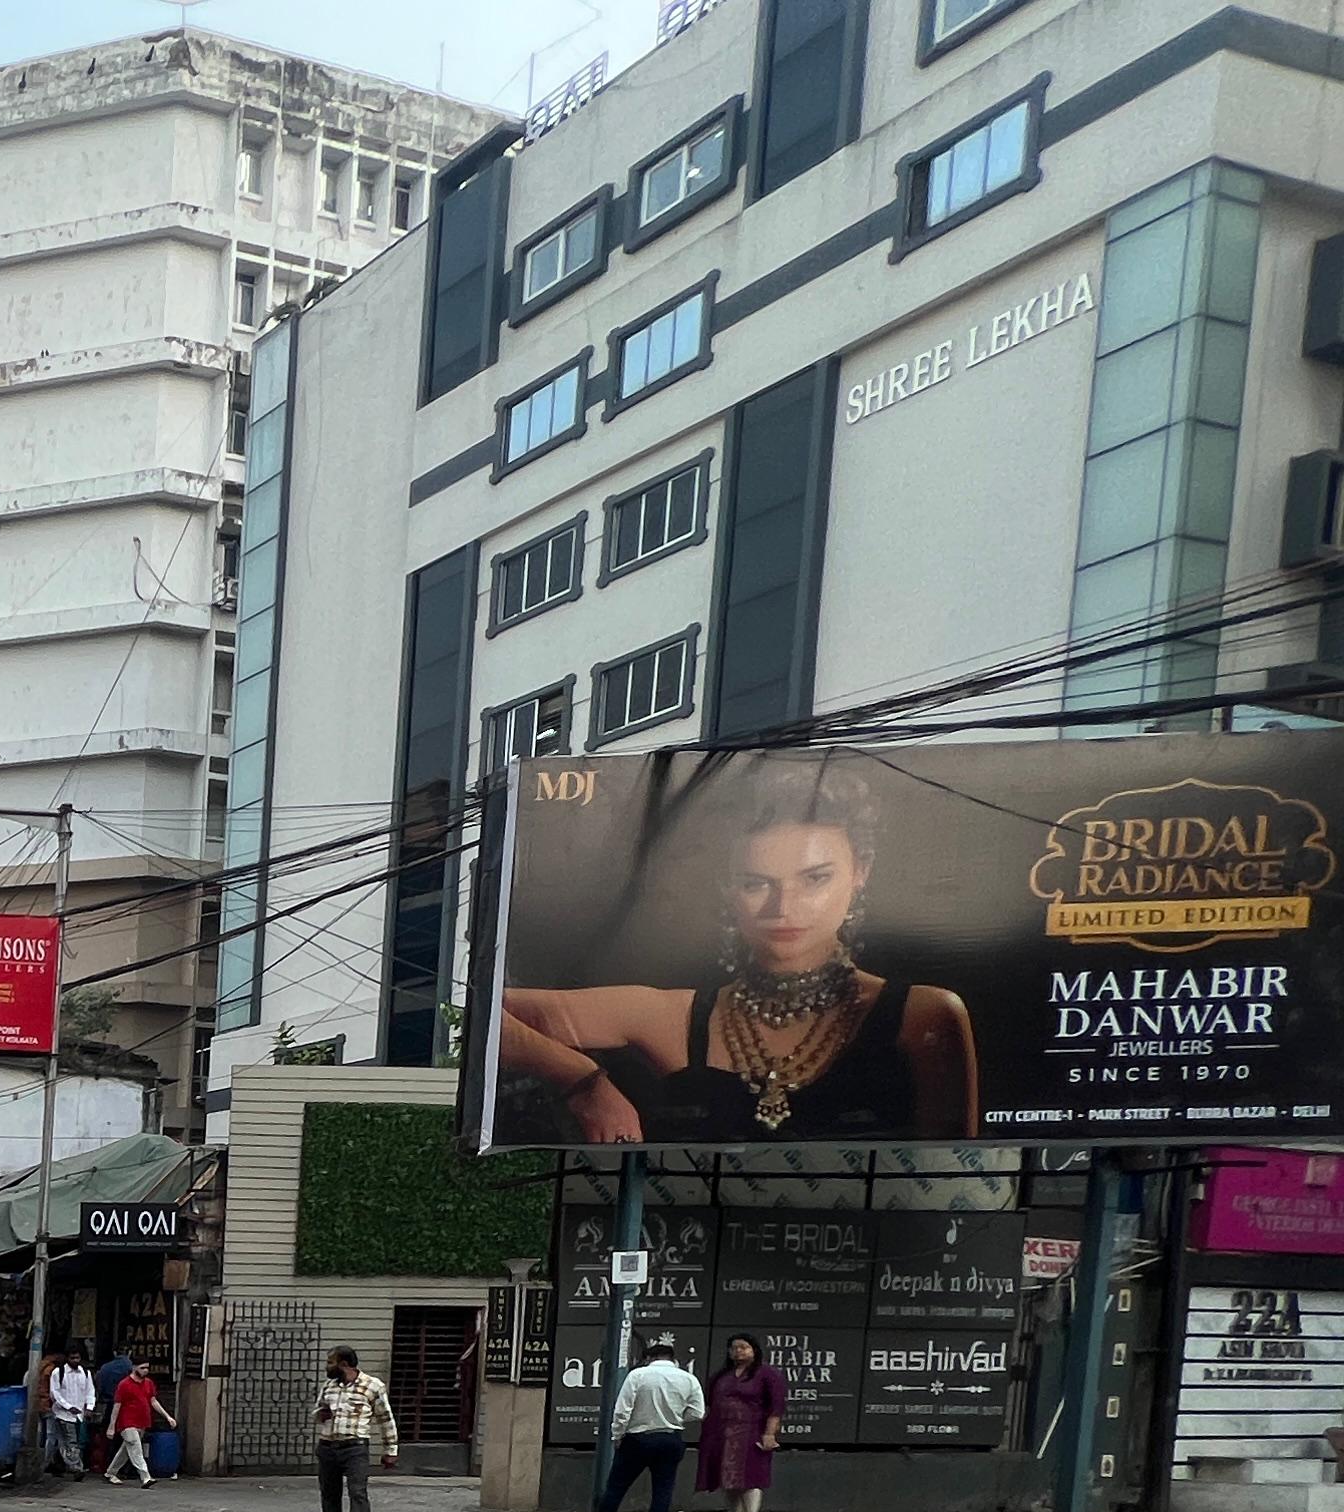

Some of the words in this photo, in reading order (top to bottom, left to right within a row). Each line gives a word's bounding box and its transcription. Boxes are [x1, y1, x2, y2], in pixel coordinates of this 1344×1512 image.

[845, 339, 953, 426] SHREE
[964, 272, 1095, 370] LEKHA
[534, 768, 600, 807] MDJ
[1080, 815, 1287, 863] BRIDAL
[1078, 860, 1285, 897] RADIANCE
[1058, 910, 1166, 928] LIMITED
[1184, 905, 1297, 925] EDITION
[1048, 966, 1289, 1003] MAHABIR
[1054, 1002, 1274, 1039] DANWAR
[1108, 1040, 1214, 1058] JEWELLERS
[1068, 1067, 1161, 1083] SINCE
[1181, 1065, 1251, 1081] 1970
[985, 1110, 1012, 1123] CITY
[1124, 1107, 1170, 1120] STREET
[727, 1223, 777, 1251] THE
[783, 1223, 869, 1252] BRIDAL
[1024, 1240, 1076, 1260] XER
[574, 1276, 698, 1297] AMIKA
[880, 1264, 944, 1298] deepak
[950, 1275, 961, 1291] n
[966, 1266, 1014, 1300] divya
[126, 1323, 169, 1341] PARK
[769, 1351, 837, 1366] HABIR
[870, 1340, 1007, 1372] aashirvad
[786, 1367, 832, 1383] WAR
[781, 1425, 812, 1434] LOOR
